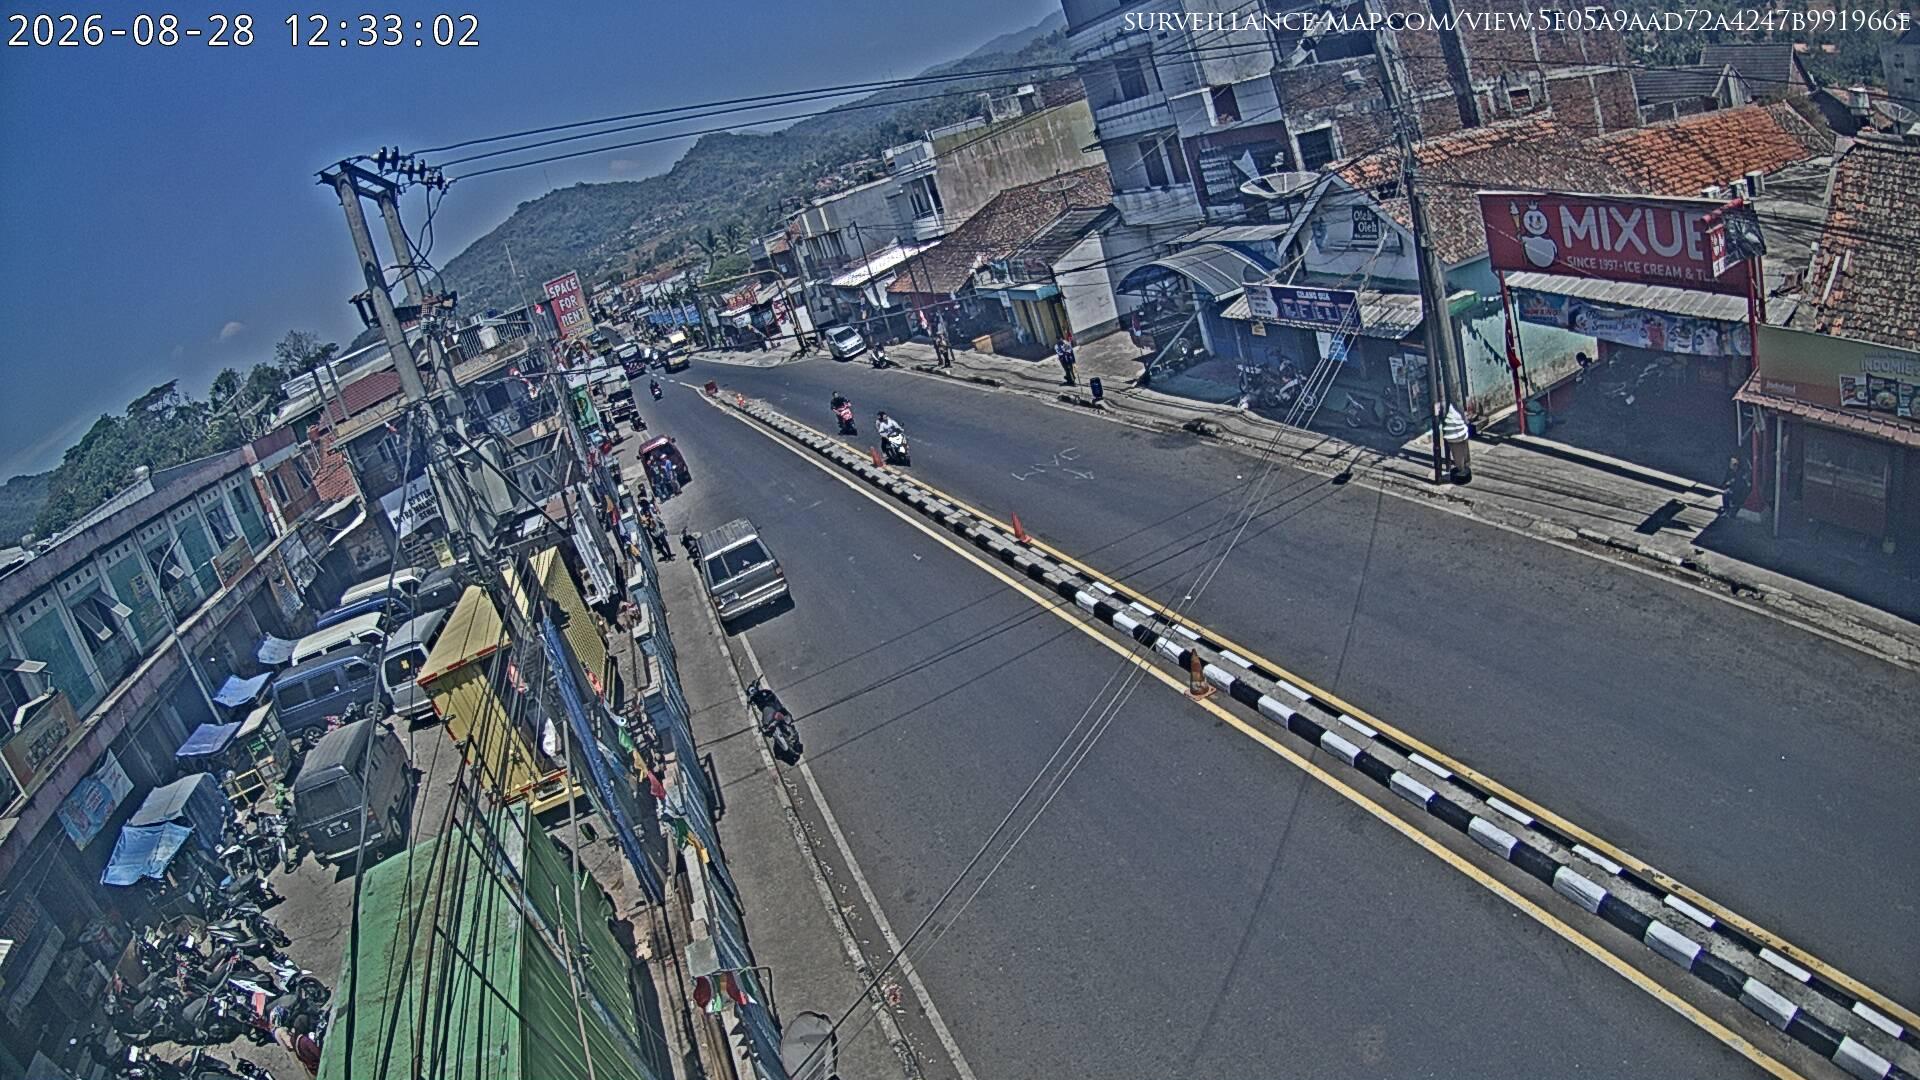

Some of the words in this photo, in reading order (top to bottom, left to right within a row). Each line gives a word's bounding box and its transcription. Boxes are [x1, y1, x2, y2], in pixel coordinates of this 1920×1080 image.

[1358, 221, 1377, 232] Oleh
[1559, 204, 1705, 261] MIXUE
[1567, 256, 1596, 269] SINCE
[1643, 263, 1682, 278] CREAM
[1685, 267, 1694, 280] &
[548, 278, 578, 298] SPACE
[559, 295, 579, 312] FOR
[560, 307, 585, 327] RENT
